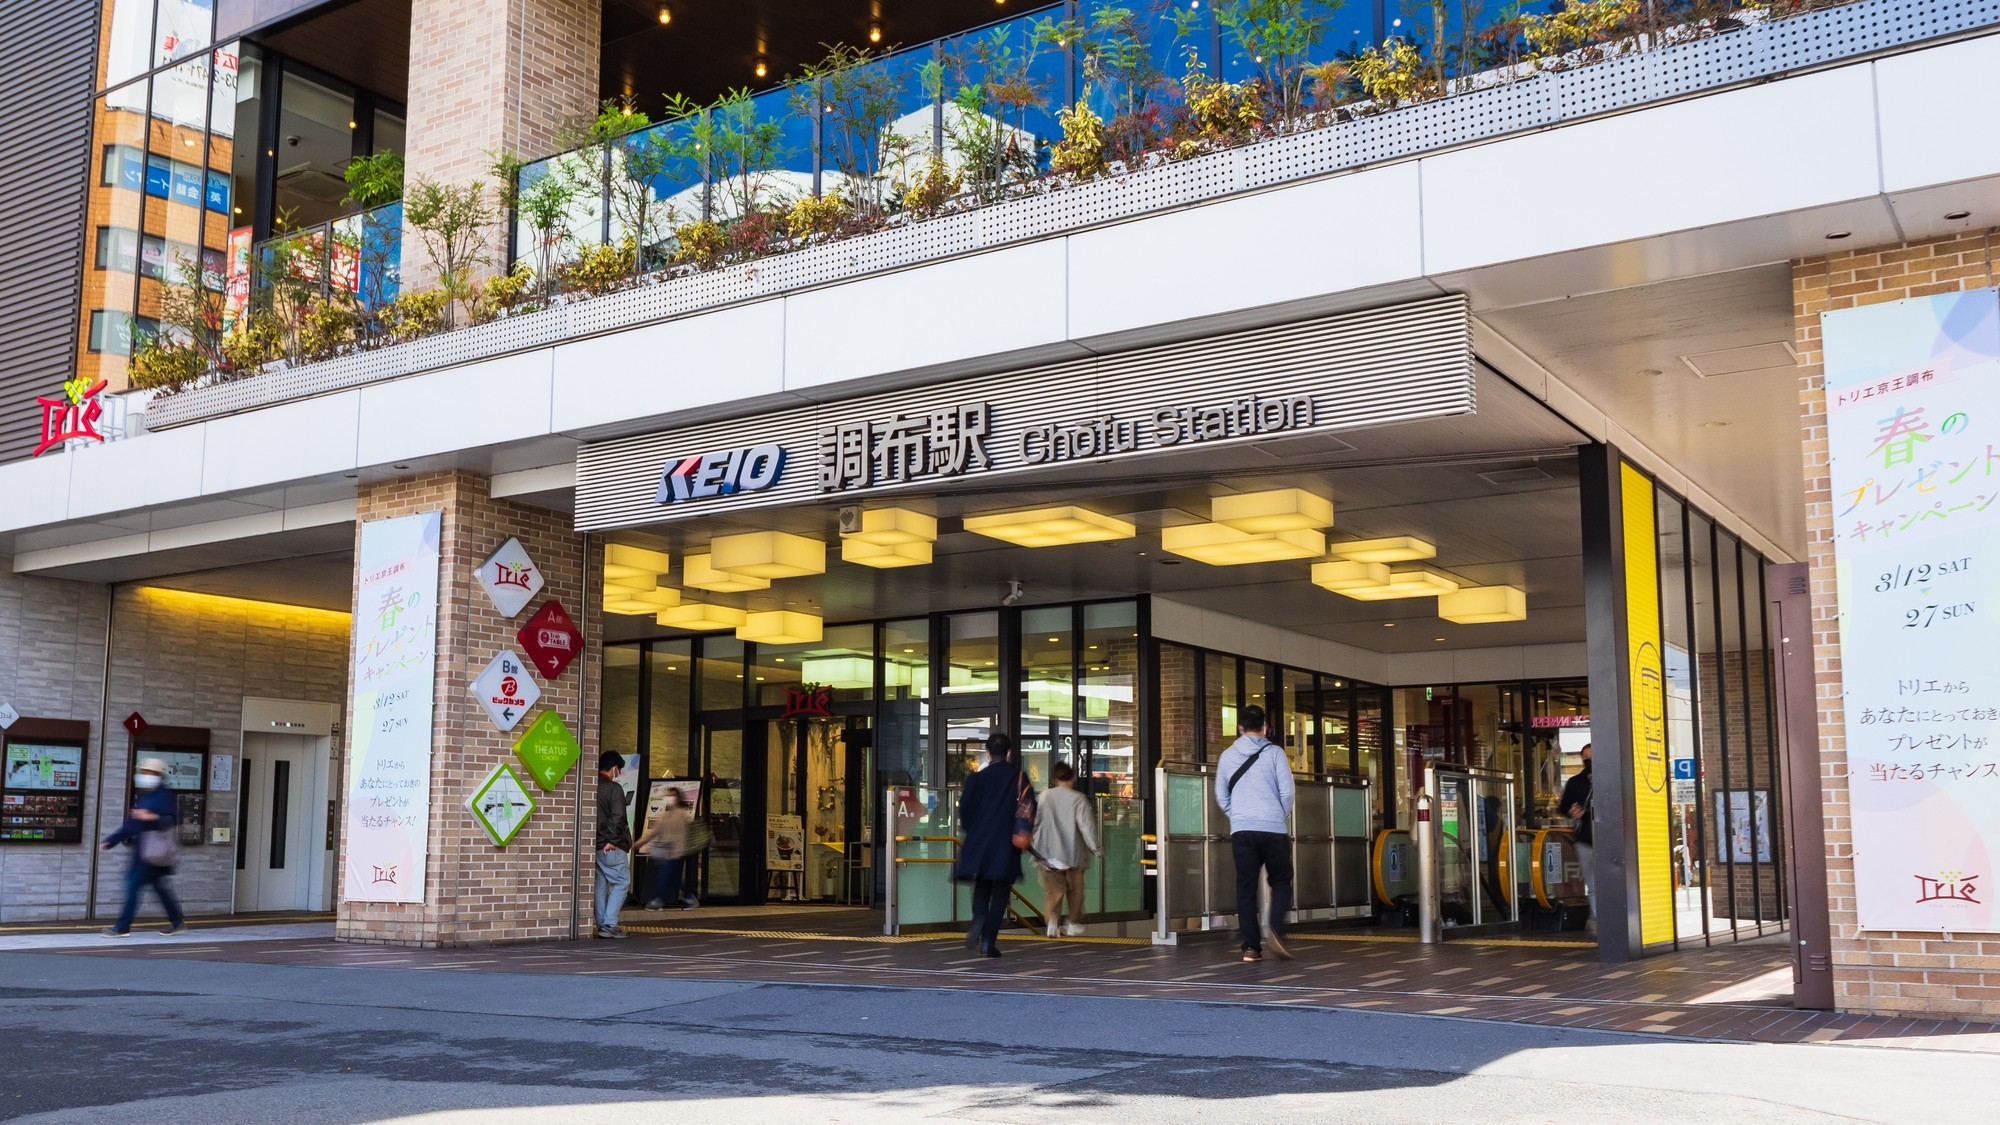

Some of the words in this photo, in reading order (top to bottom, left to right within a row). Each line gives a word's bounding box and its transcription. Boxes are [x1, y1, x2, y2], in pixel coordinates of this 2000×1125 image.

[1838, 369, 1934, 406] トリエ京王調布
[1151, 393, 1316, 446] Station
[817, 401, 992, 492] 調布駅
[1866, 406, 1969, 470] 春の
[654, 444, 788, 503] KEIO
[1838, 444, 2000, 518] プレゼント
[1850, 491, 1999, 542] キャンペーン
[1875, 564, 1931, 592] 3/12
[1938, 557, 1972, 576] SAT
[375, 585, 421, 632] 春の
[1902, 604, 1939, 629] 27
[1942, 601, 1976, 620] SUN
[358, 615, 434, 665] プレゼント
[363, 649, 430, 683] キャンペーン
[373, 692, 395, 710] 3/12
[491, 696, 526, 707] ビックカメラ
[1898, 679, 1970, 696] トリエから
[381, 718, 395, 733] 27
[1860, 706, 2000, 725] あなたにとっておき
[534, 744, 568, 756] THEATUS
[1888, 733, 1988, 752] プレゼントが
[376, 759, 406, 770] トリエから
[1869, 763, 1999, 782] 当たるチャンス
[360, 777, 420, 789] あなたにとっておきの
[370, 796, 410, 808] プレゼントが
